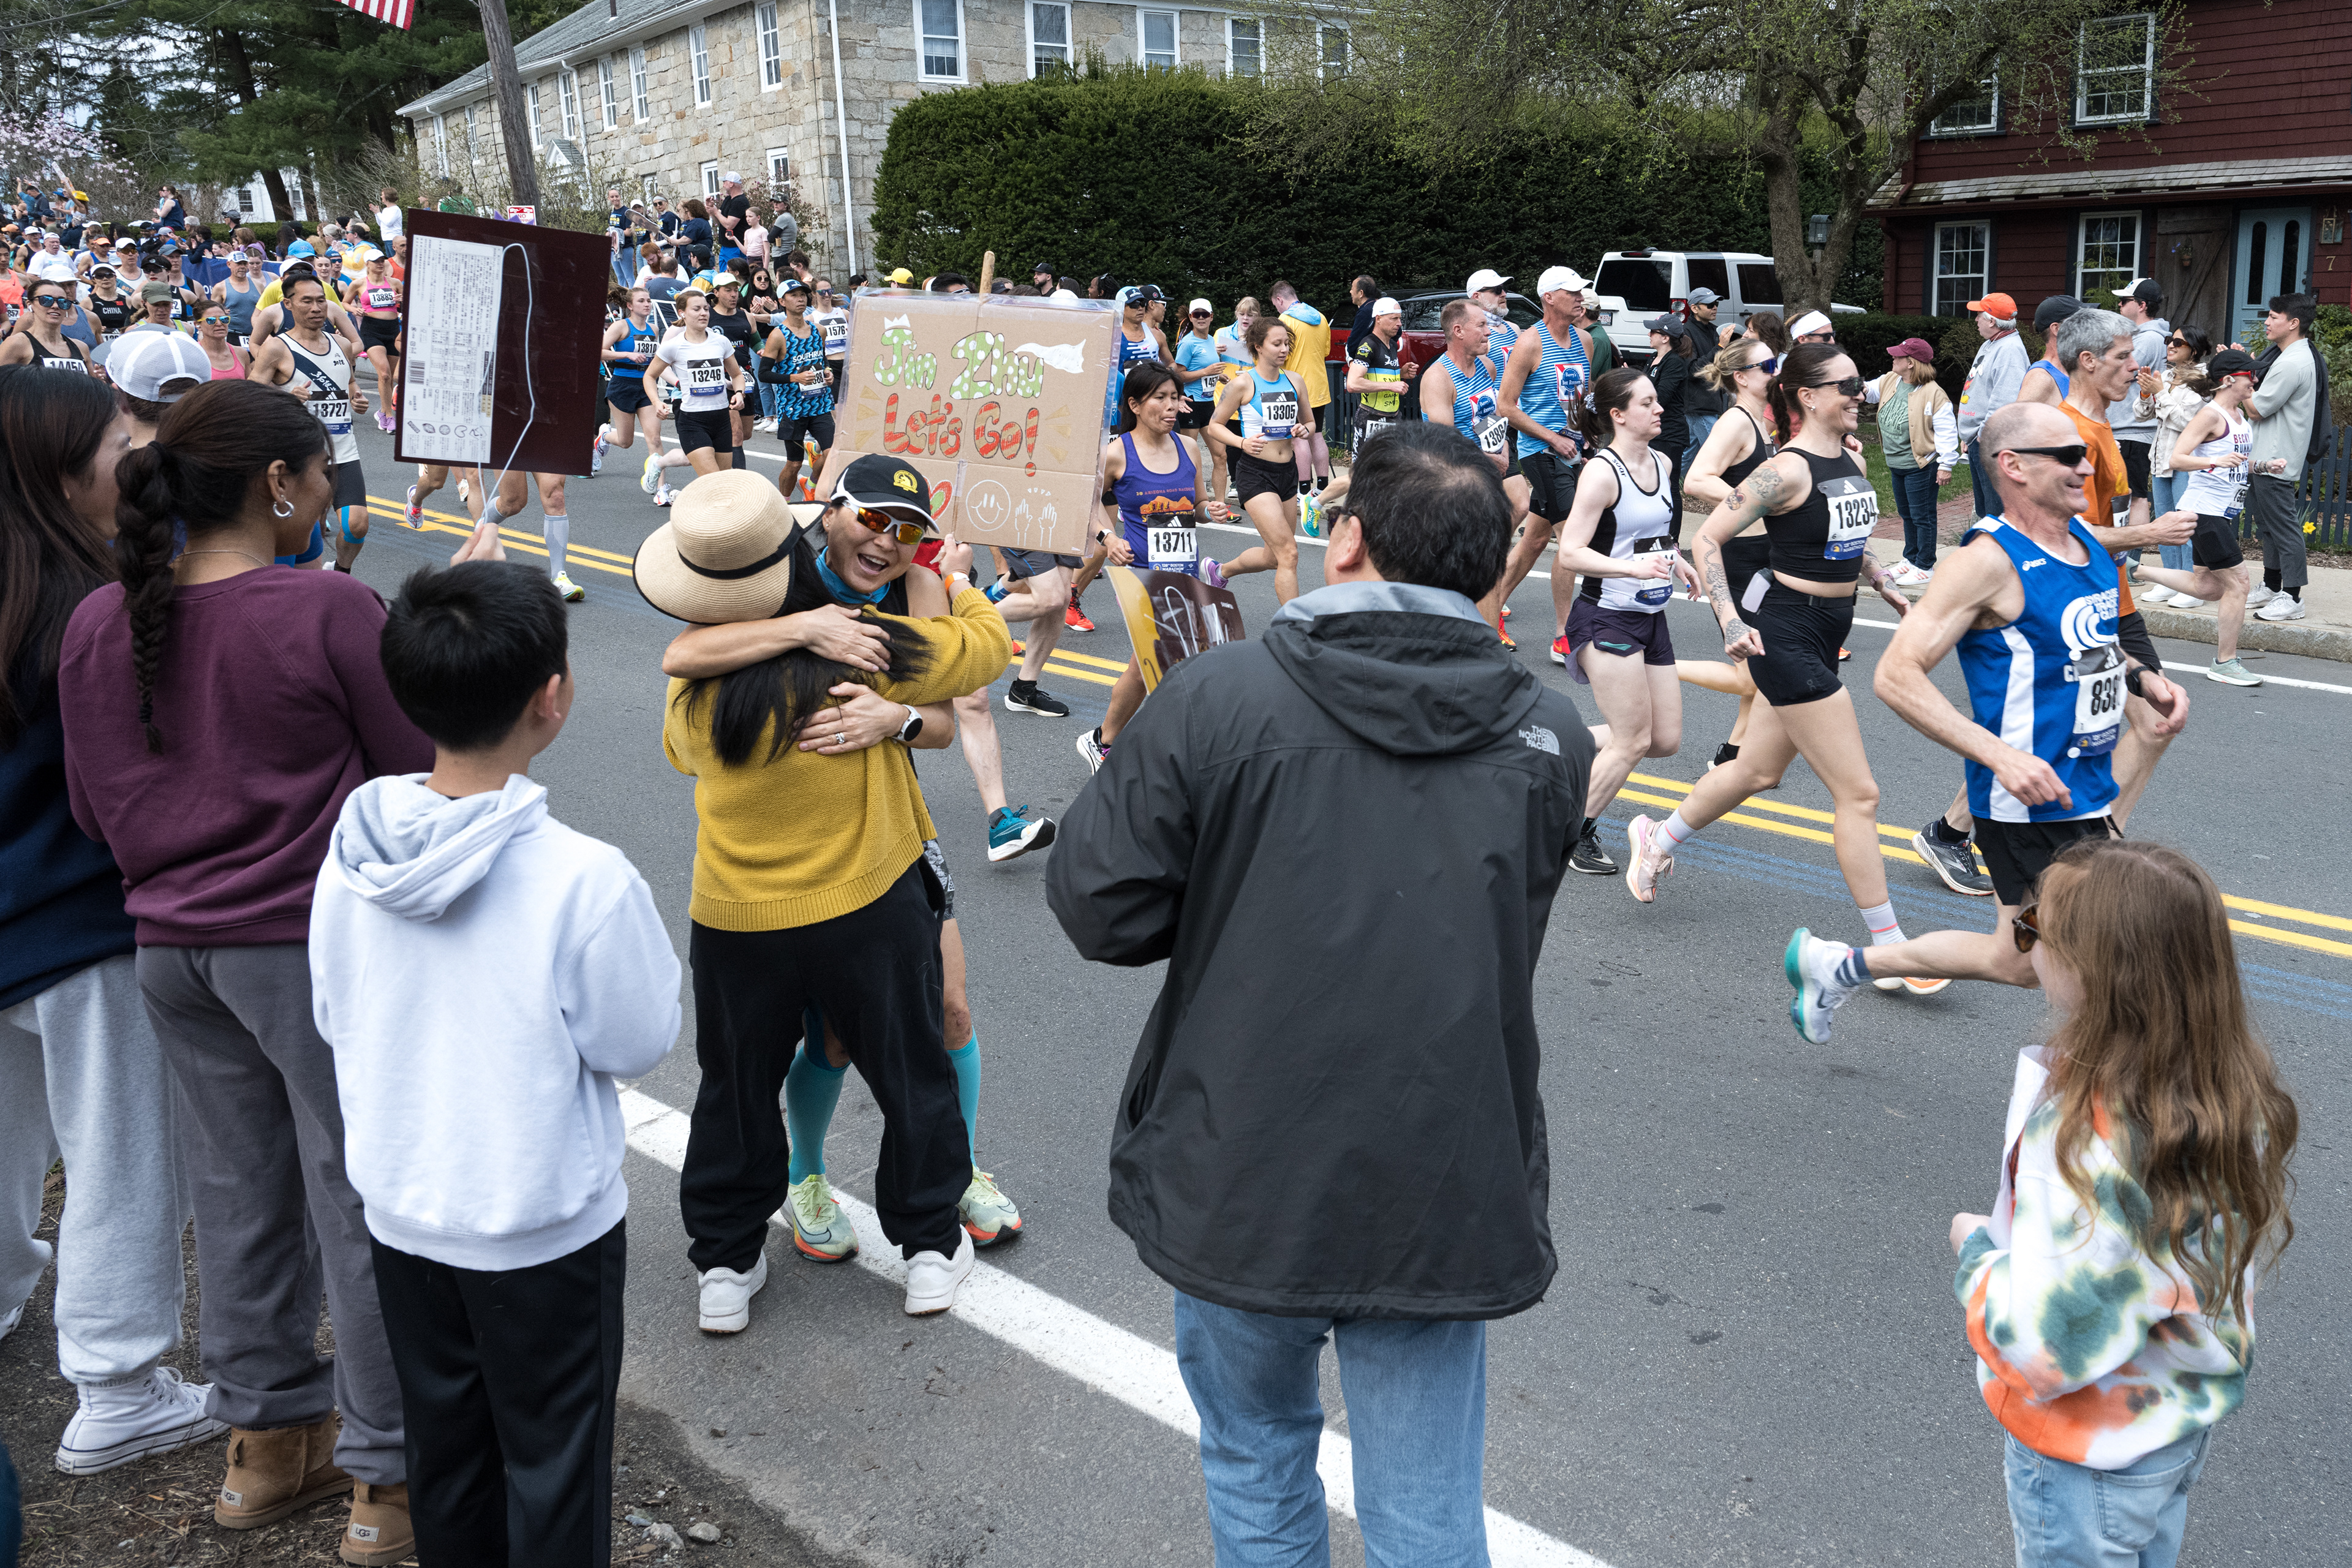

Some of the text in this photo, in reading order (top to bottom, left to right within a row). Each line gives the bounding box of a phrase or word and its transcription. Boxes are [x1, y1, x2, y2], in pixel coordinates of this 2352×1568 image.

[2326, 256, 2336, 271] 7
[372, 293, 393, 302] 13885
[826, 325, 846, 336] 1576
[638, 343, 657, 353] 13810
[873, 328, 1044, 400] Jin Zhu
[692, 369, 722, 383] 13246
[313, 402, 348, 418] 13727
[1267, 404, 1296, 421] 13305
[883, 393, 1039, 477] Let's Go!
[2233, 434, 2250, 444] BECKY
[1611, 459, 1627, 477] soar
[1836, 497, 1877, 529] 13234
[1154, 532, 1193, 552] 13711
[1518, 729, 1547, 743] NORTH
[1531, 725, 1547, 735] THE
[1526, 739, 1547, 752] FACE
[224, 1490, 235, 1501] UGG
[355, 1528, 371, 1537] UGG
